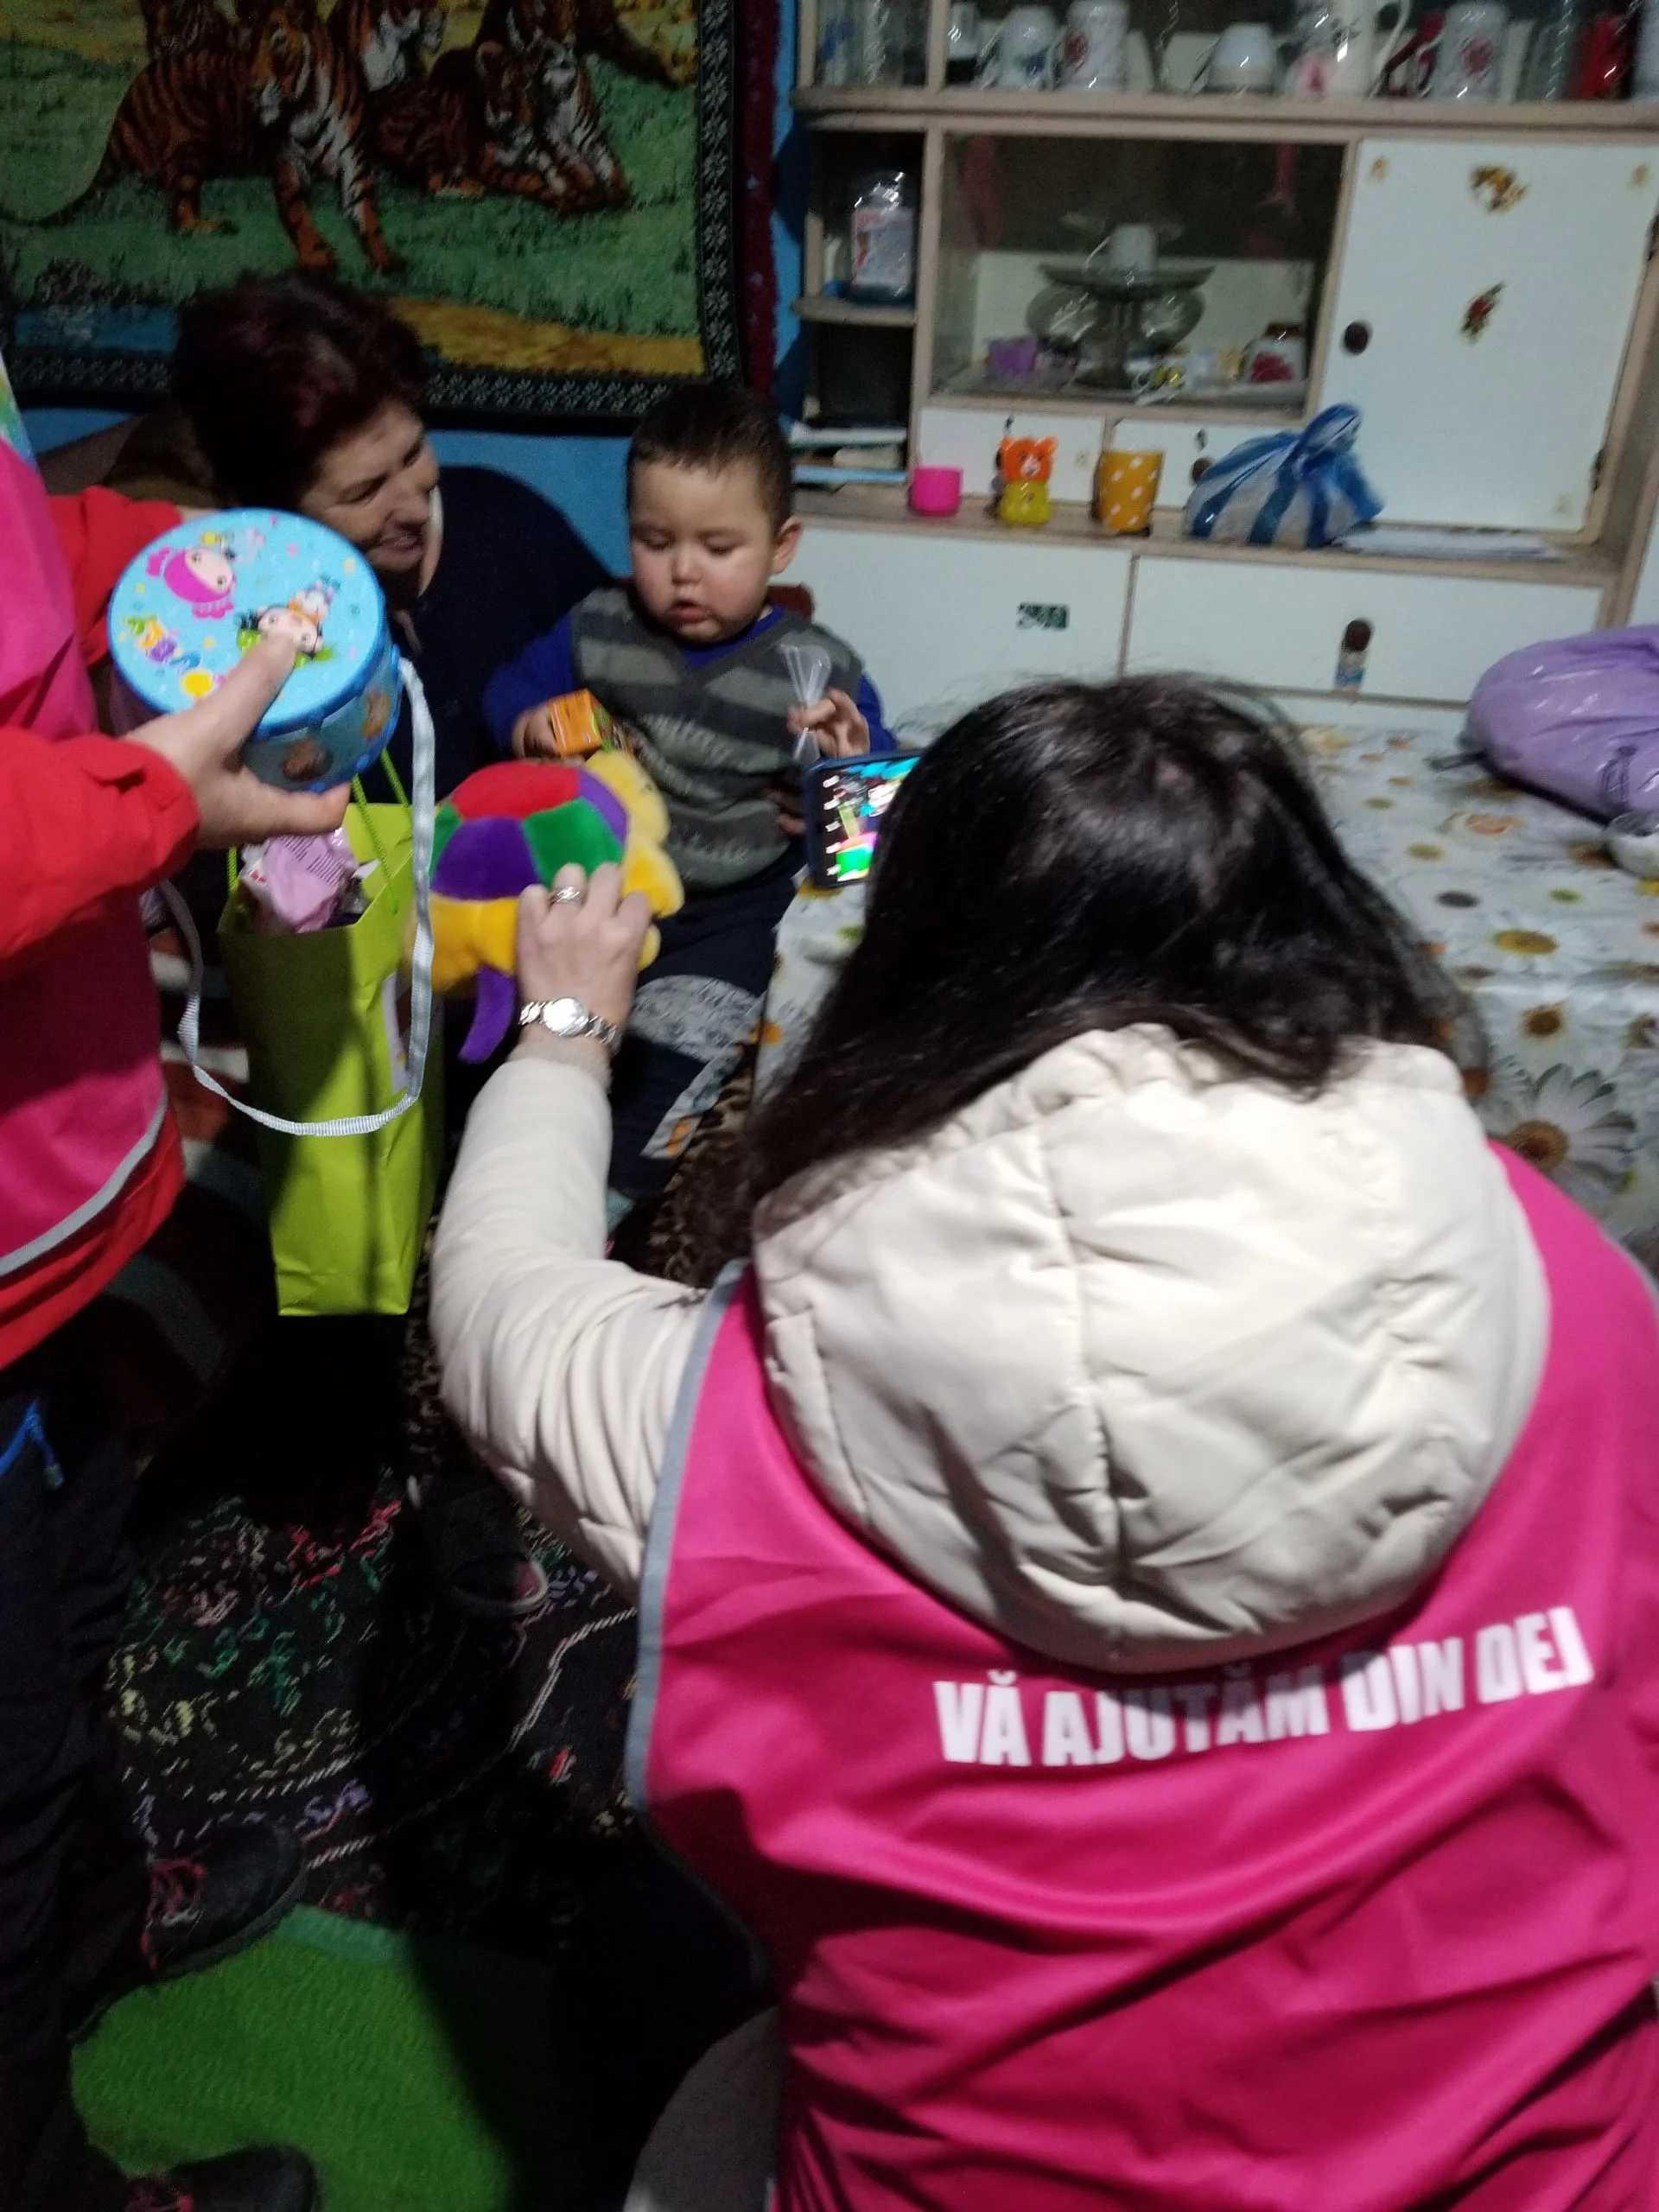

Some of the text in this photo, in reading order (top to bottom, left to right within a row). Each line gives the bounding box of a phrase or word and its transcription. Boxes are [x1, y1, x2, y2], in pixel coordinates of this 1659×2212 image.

[934, 1606, 1594, 1766] VĂ AJUTĂM DIN DEJ
